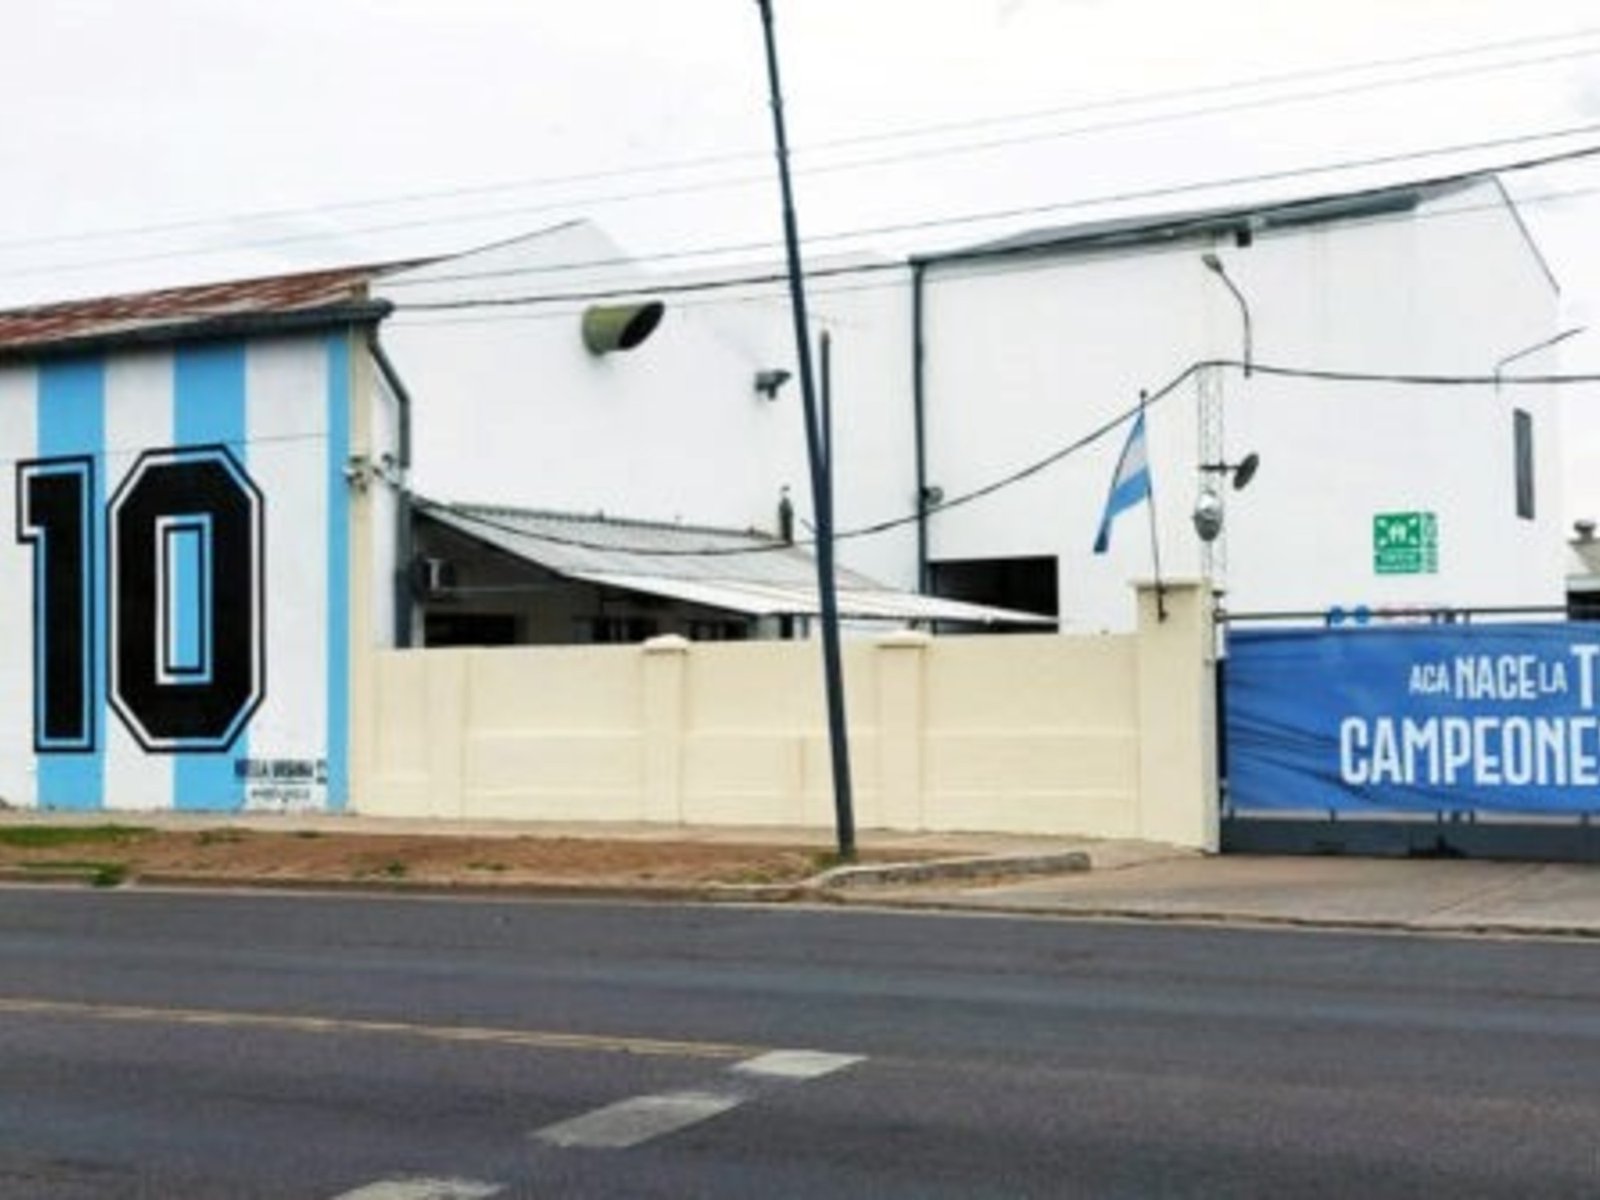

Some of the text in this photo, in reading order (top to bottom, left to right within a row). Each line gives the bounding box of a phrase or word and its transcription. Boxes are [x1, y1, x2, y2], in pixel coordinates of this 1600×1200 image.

[16, 443, 265, 755] 10
[1408, 662, 1450, 695] ACA
[1455, 654, 1538, 700] NACE
[1539, 661, 1568, 693] LA
[1339, 715, 1600, 787] CAMPEONE
